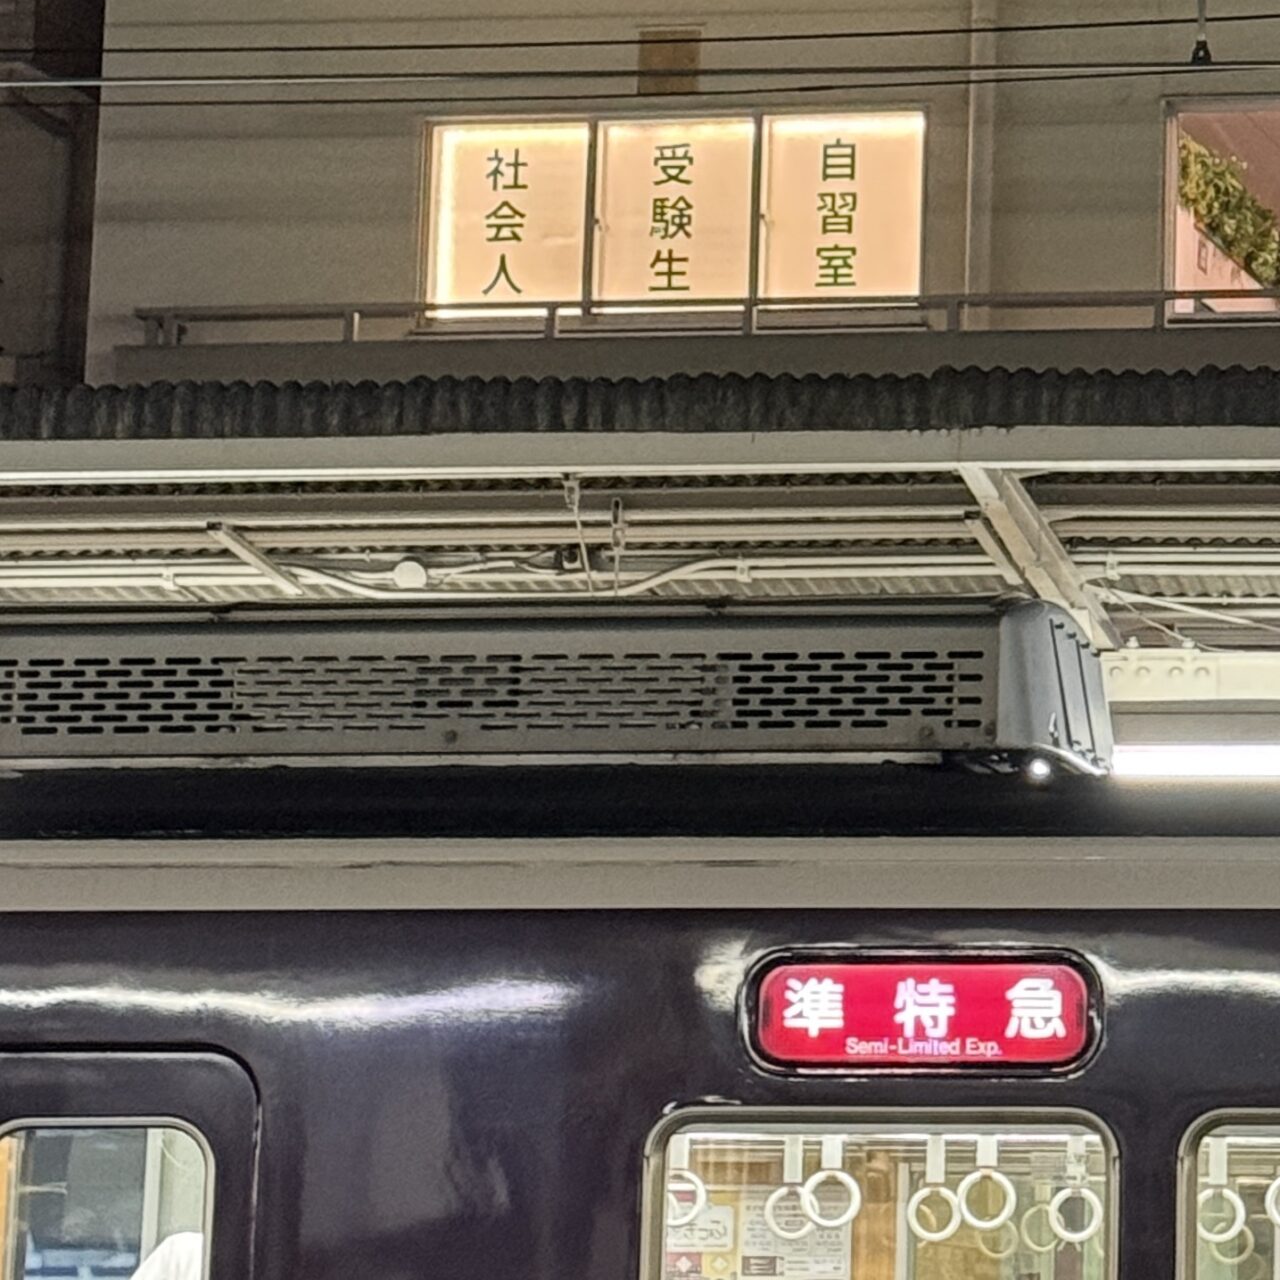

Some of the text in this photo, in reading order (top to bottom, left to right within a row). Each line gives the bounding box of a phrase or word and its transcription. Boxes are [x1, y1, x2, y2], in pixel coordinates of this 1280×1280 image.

[482, 147, 529, 295] 社会人
[649, 143, 694, 293] 受験生
[815, 138, 857, 288] 自習室
[782, 977, 1067, 1039] 準特急
[844, 1037, 1003, 1058] Semi-Limited Exp.
